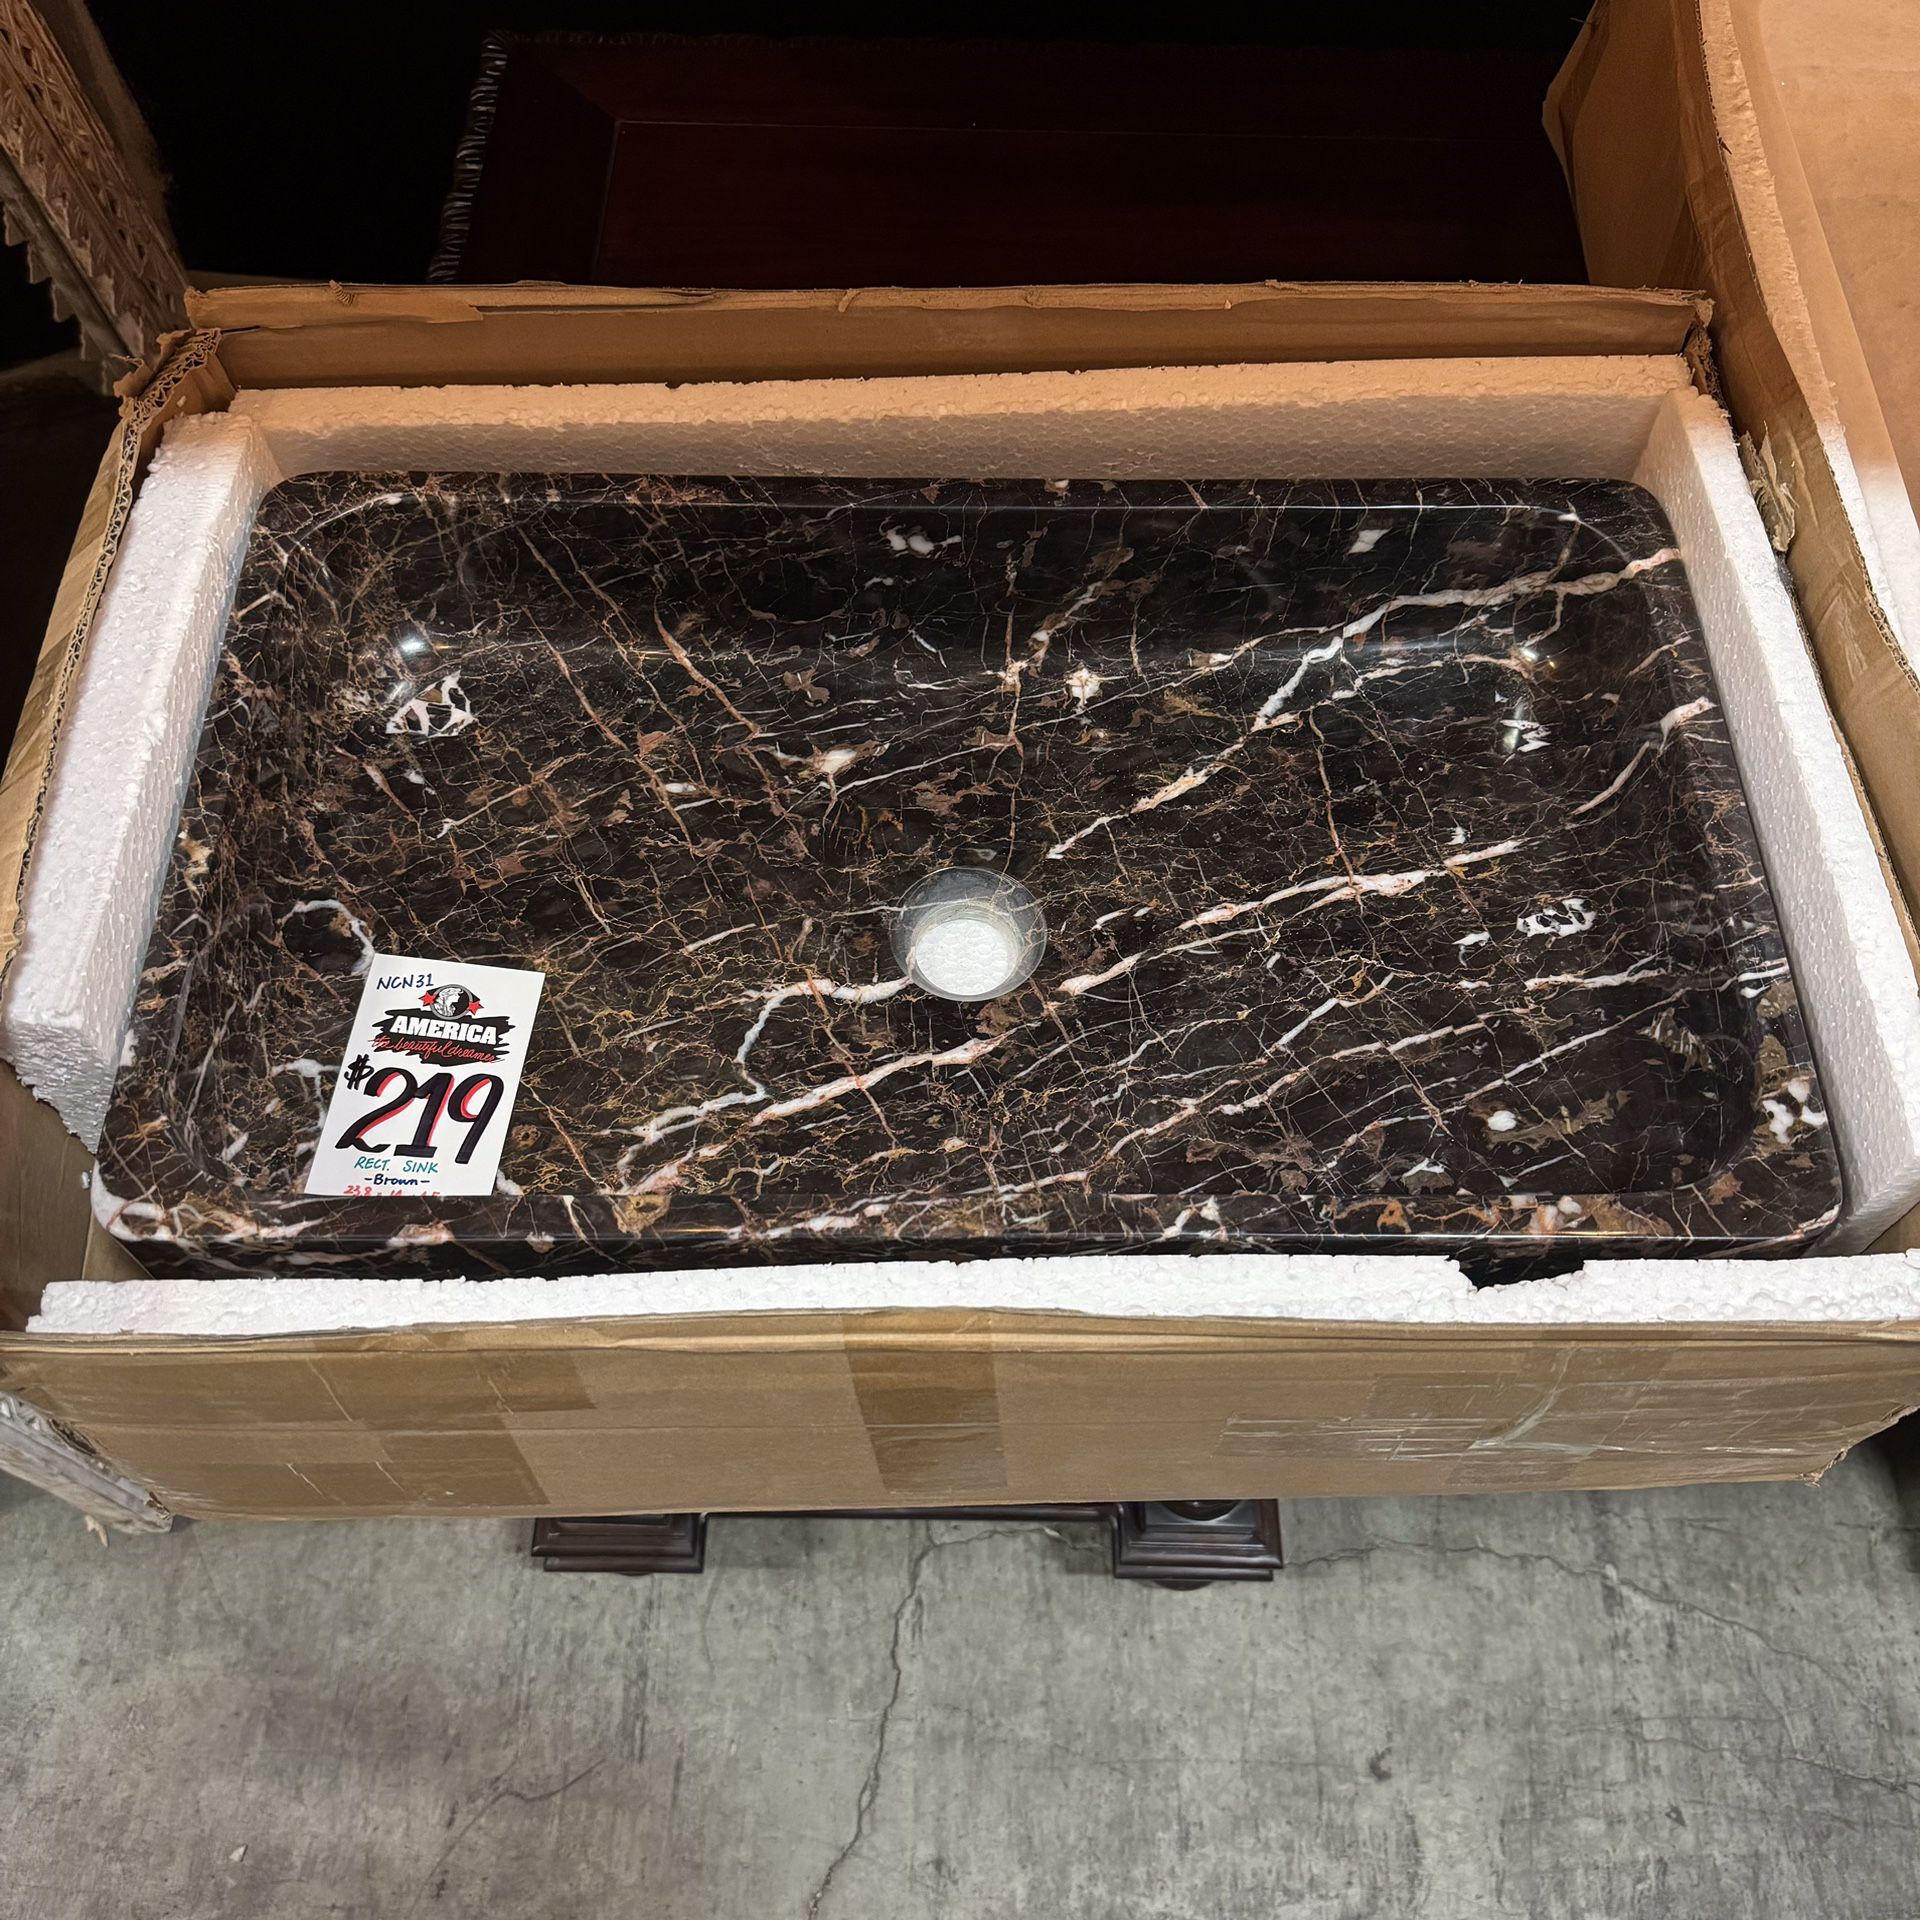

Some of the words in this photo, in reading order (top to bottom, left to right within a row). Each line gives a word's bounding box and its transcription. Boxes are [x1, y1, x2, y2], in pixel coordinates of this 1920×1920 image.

[376, 973, 434, 990] NCN31
[389, 1015, 498, 1045] AMERICA
[394, 1037, 452, 1060] beautiful
[335, 1054, 505, 1165] $219
[354, 1156, 391, 1171] RECT.
[402, 1160, 439, 1174] SINK
